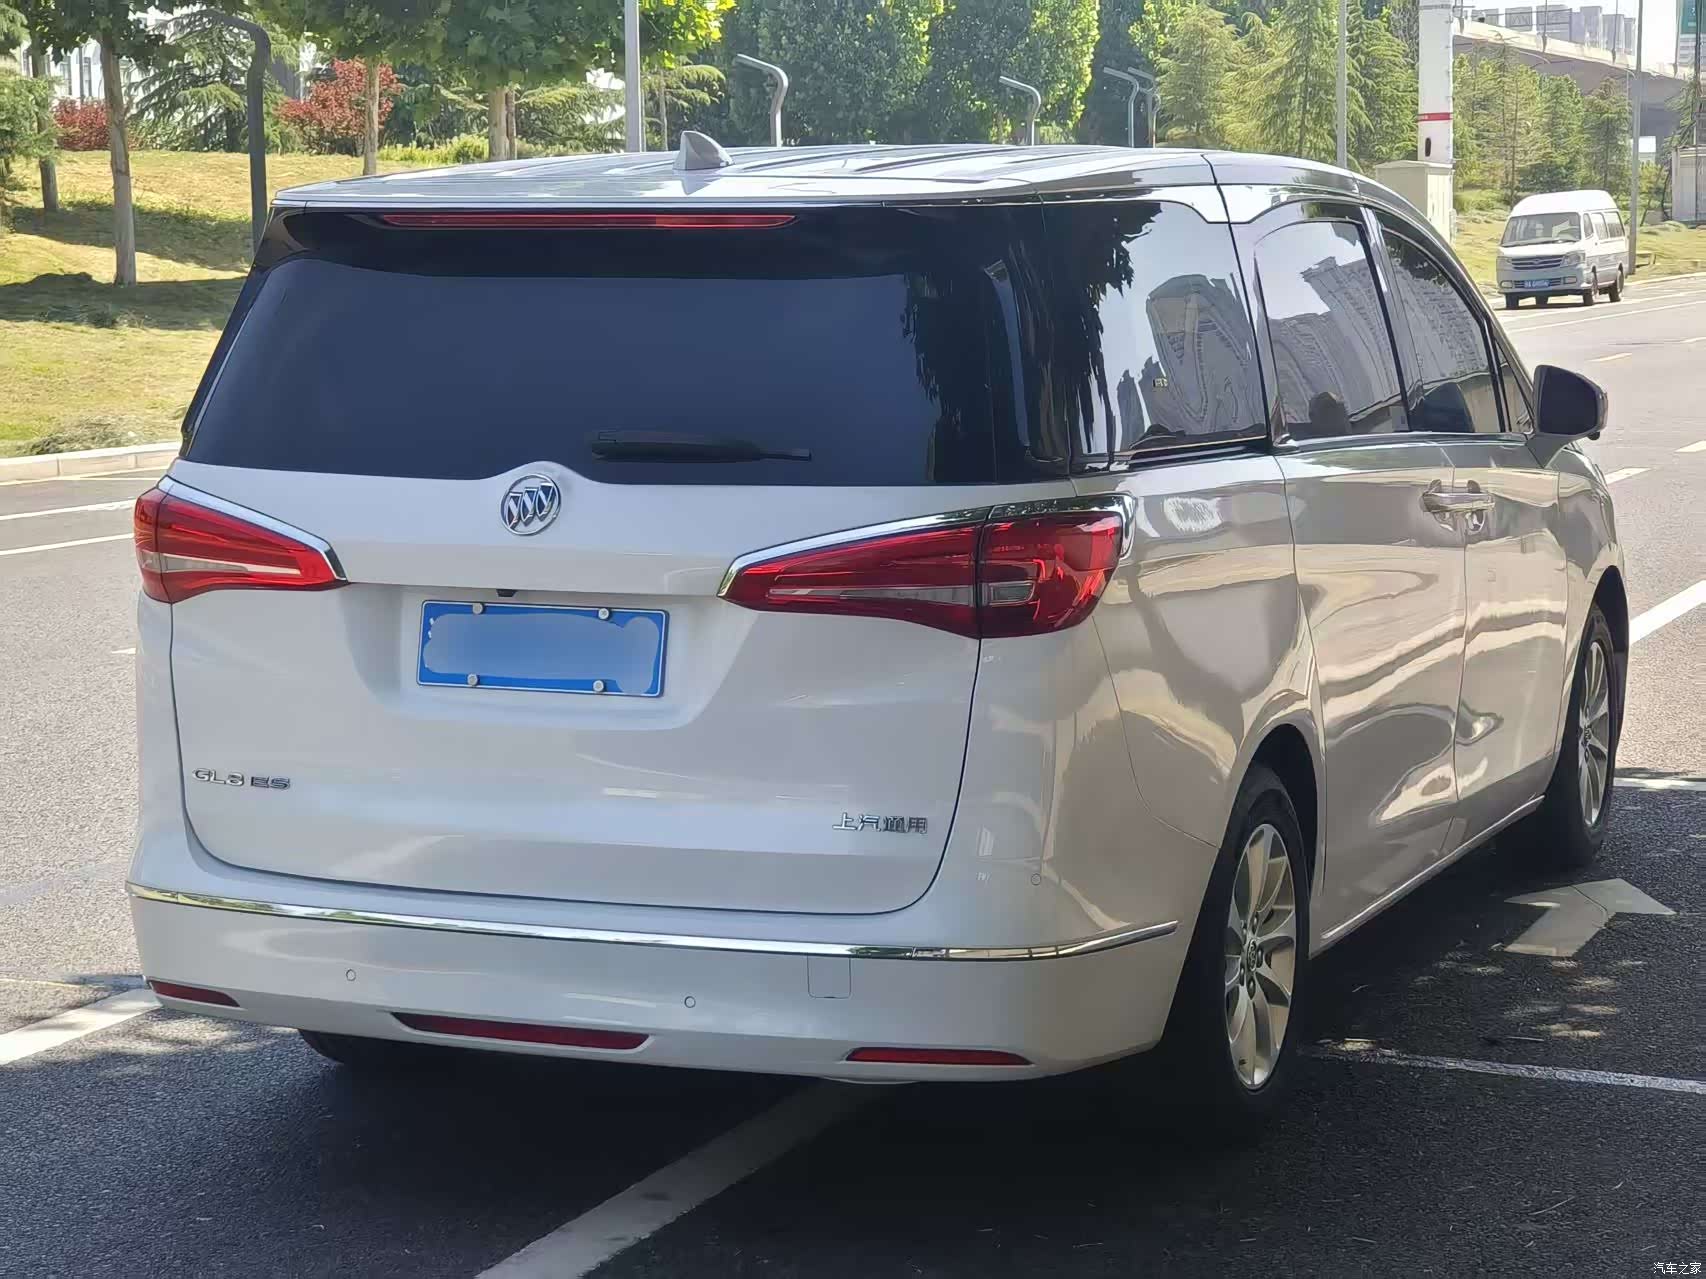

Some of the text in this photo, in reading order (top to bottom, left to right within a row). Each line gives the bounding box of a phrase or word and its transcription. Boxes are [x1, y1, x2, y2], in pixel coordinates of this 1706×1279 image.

[192, 768, 290, 790] GL8 ES
[832, 811, 928, 834] 上汽通用
